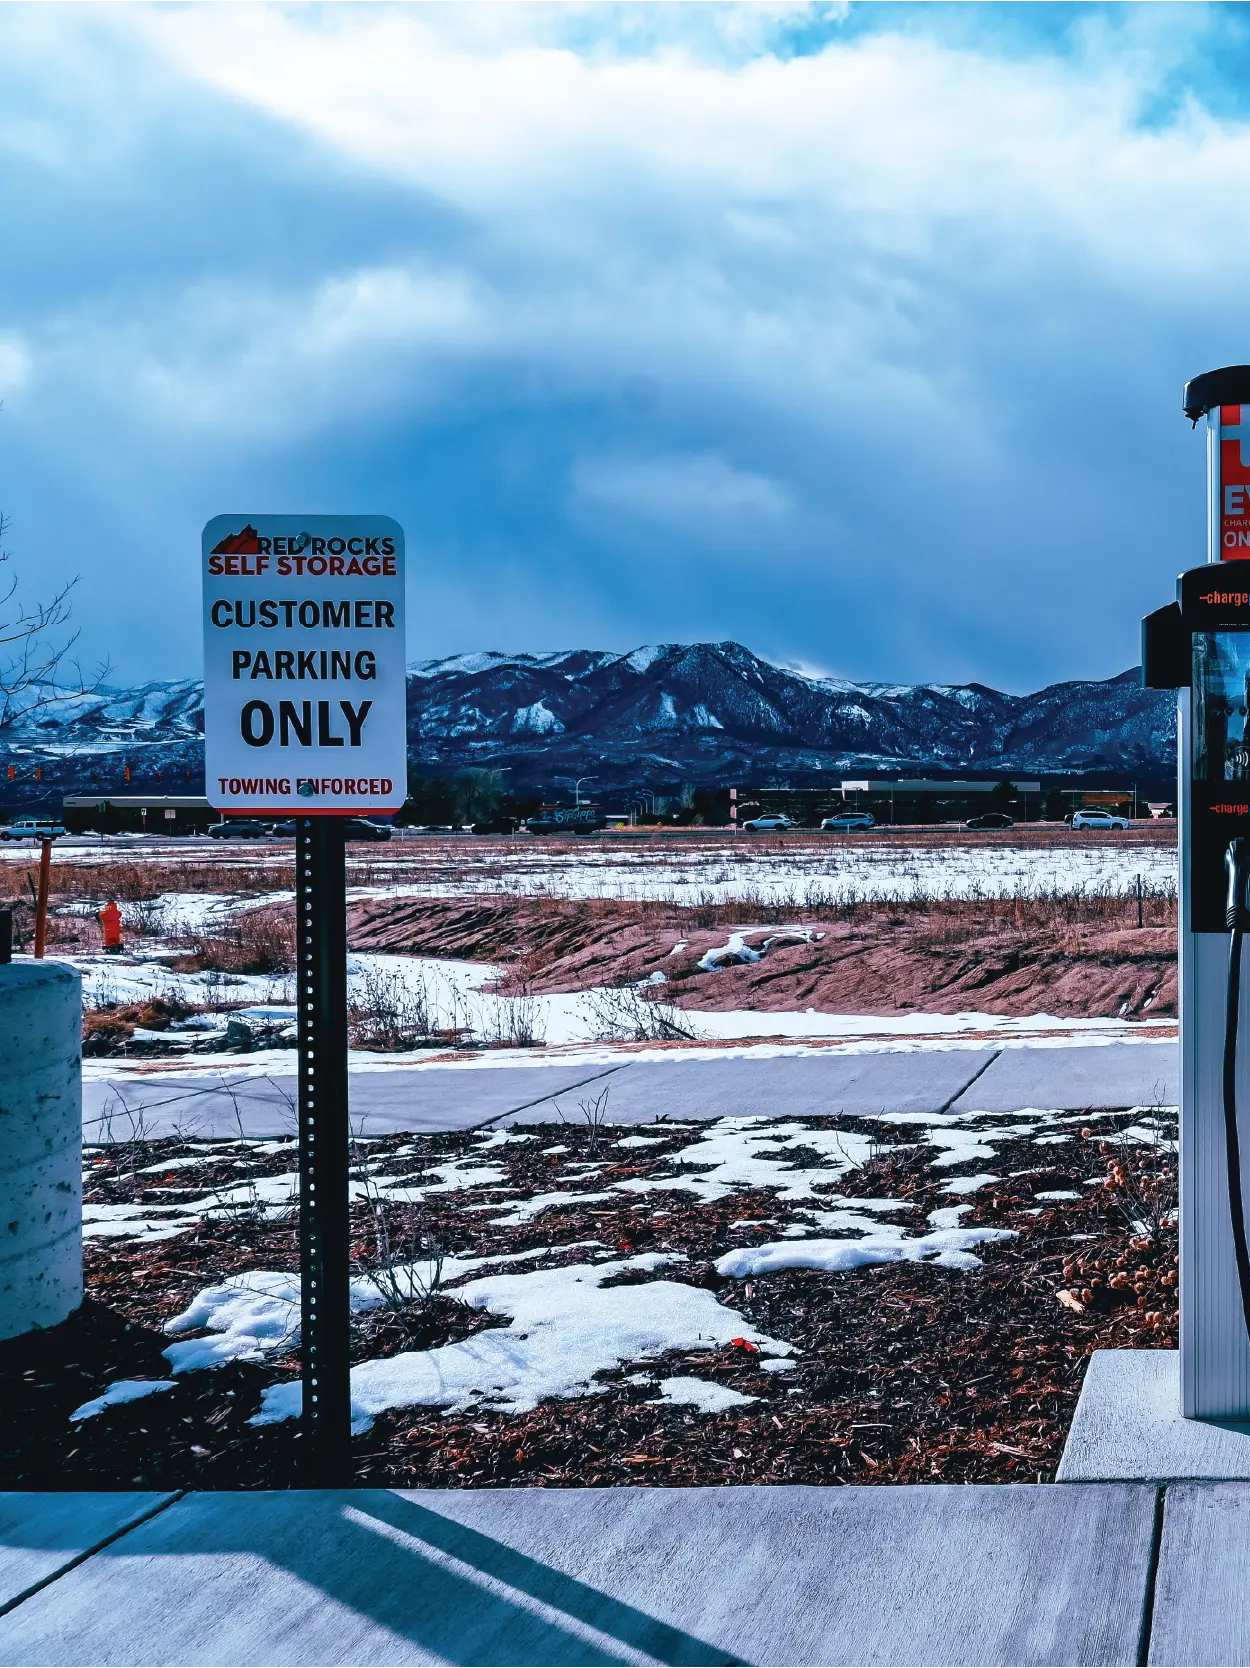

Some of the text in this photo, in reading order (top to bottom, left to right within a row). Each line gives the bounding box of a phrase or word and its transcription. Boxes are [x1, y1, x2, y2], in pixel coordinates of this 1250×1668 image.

[258, 536, 395, 555] RED ROCKS
[208, 556, 397, 576] SELF STORAGE
[211, 600, 395, 628] CUSTOMER
[232, 650, 376, 680] PARKING
[240, 699, 373, 747] ONLY
[218, 778, 291, 794] TOWING
